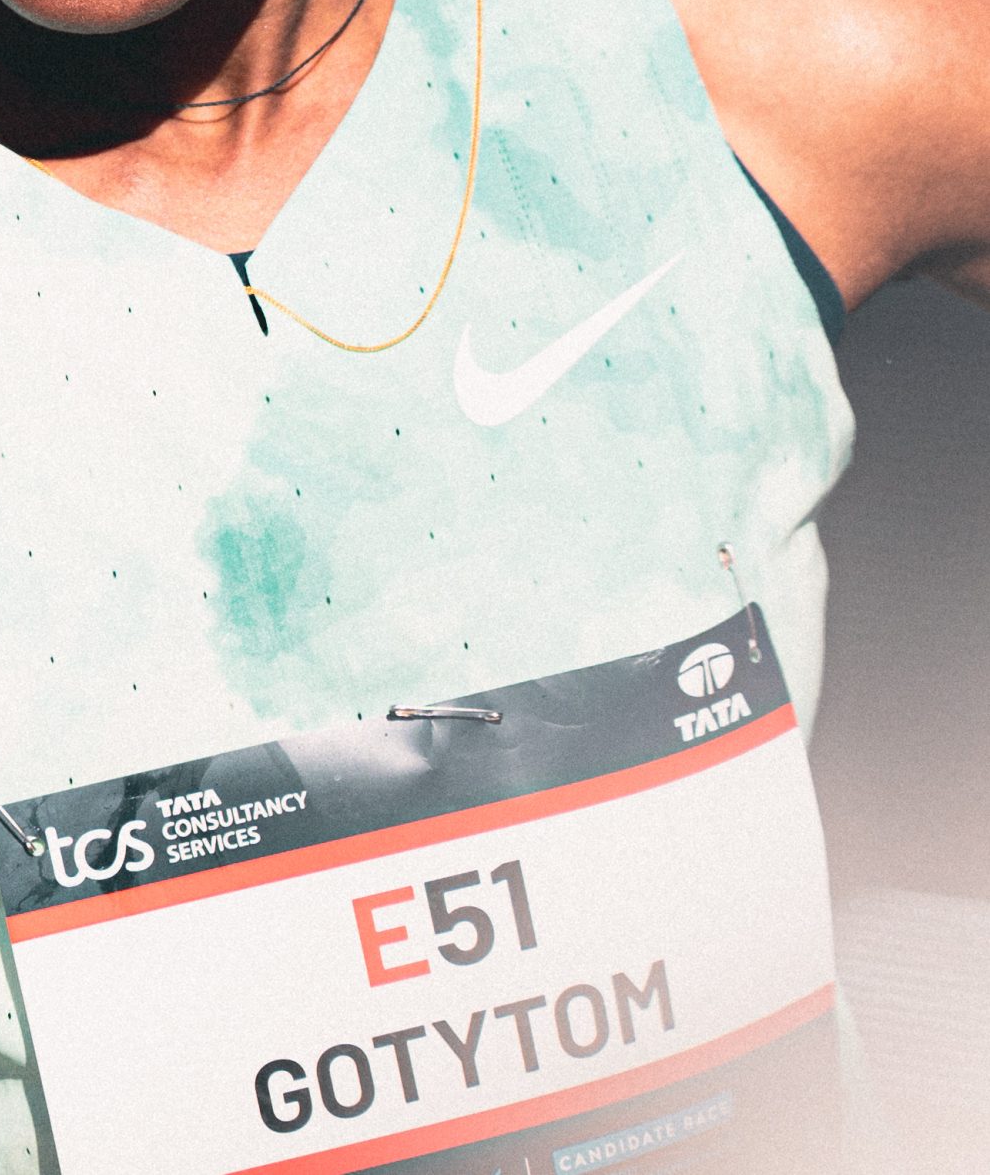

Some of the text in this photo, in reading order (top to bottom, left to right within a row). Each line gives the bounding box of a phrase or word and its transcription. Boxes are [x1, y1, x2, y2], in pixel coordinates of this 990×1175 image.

[673, 692, 752, 742] TATA
[156, 789, 222, 818] TATA
[161, 791, 308, 840] CONSULTANCY
[44, 819, 155, 888] tcs
[166, 826, 261, 864] SERVICES
[352, 859, 537, 987] E51
[255, 959, 675, 1133] GOTYTOM
[559, 1123, 677, 1172] CANDIDATE
[683, 1099, 732, 1128] RACE
